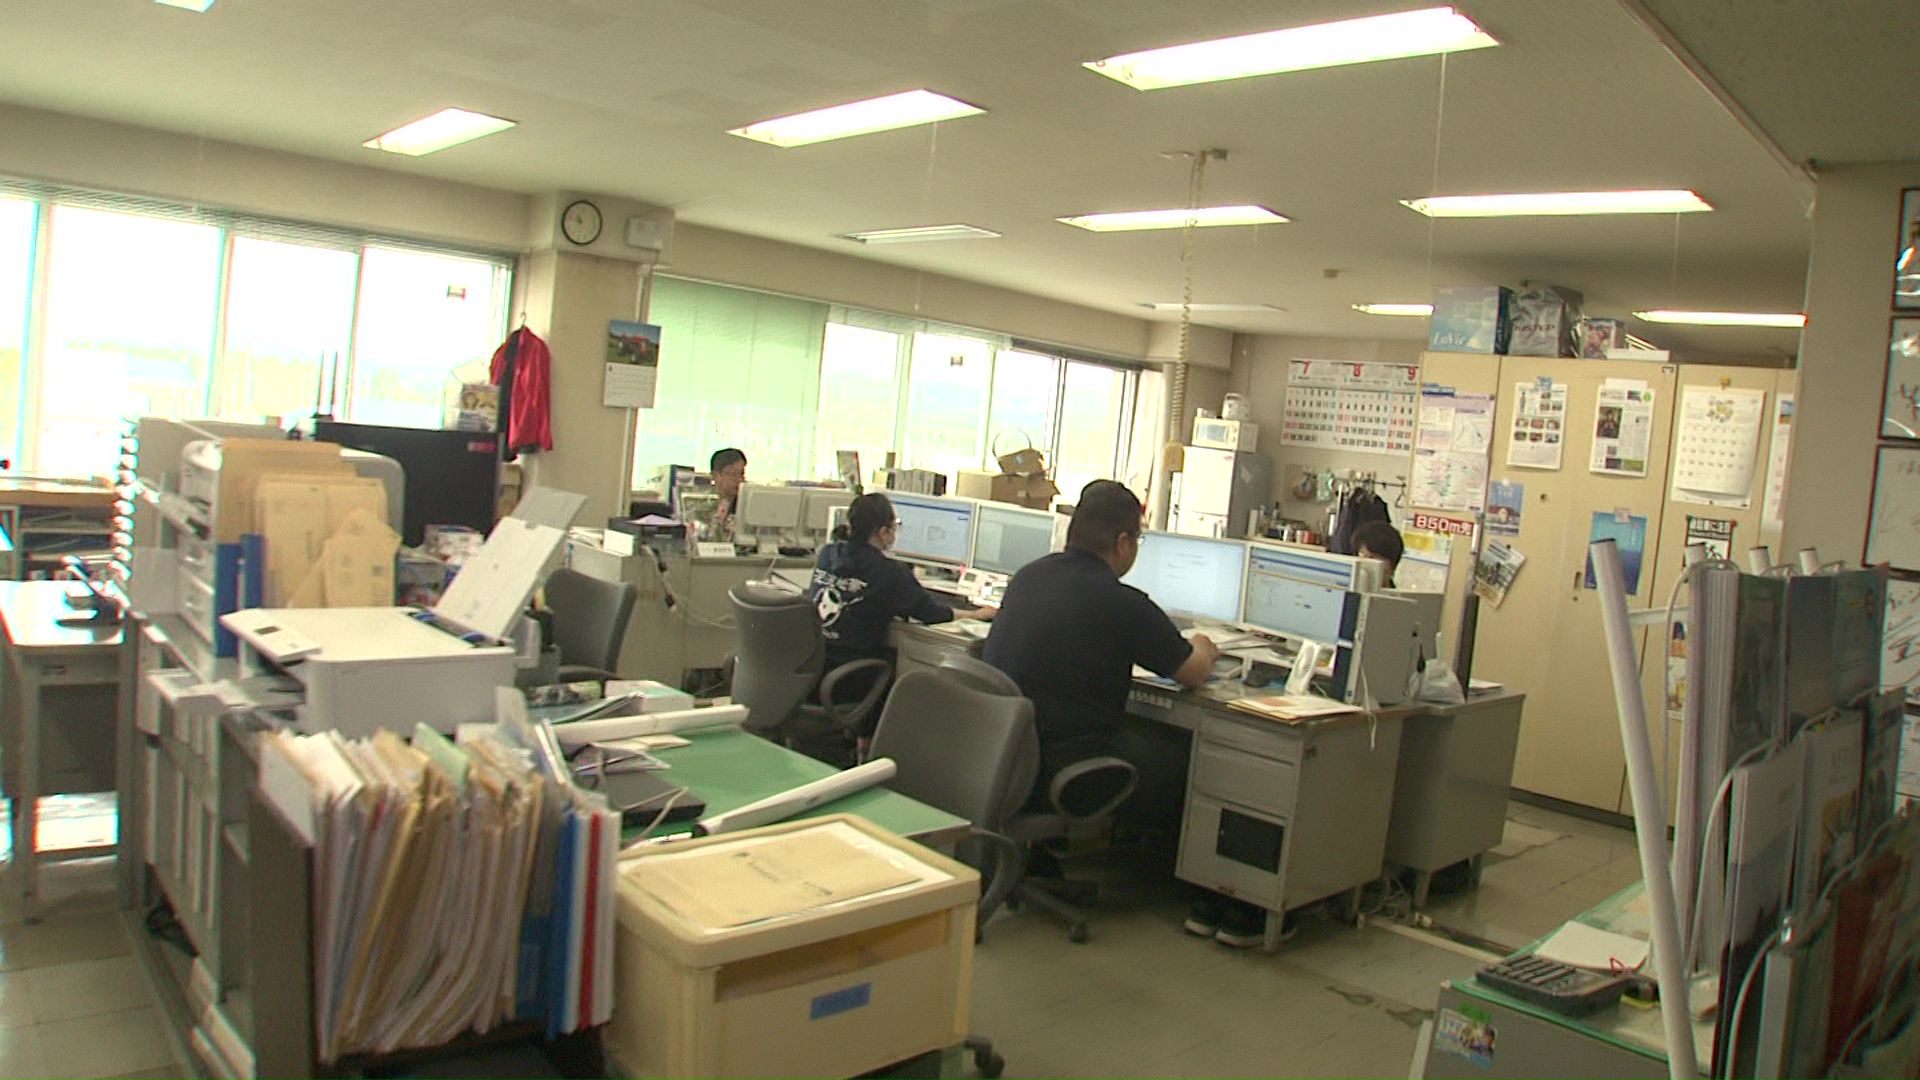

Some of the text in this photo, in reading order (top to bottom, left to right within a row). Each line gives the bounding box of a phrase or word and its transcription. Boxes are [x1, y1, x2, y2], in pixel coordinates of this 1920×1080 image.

[1303, 362, 1310, 374] 7
[1353, 364, 1361, 377] 8
[1408, 366, 1416, 380] 9
